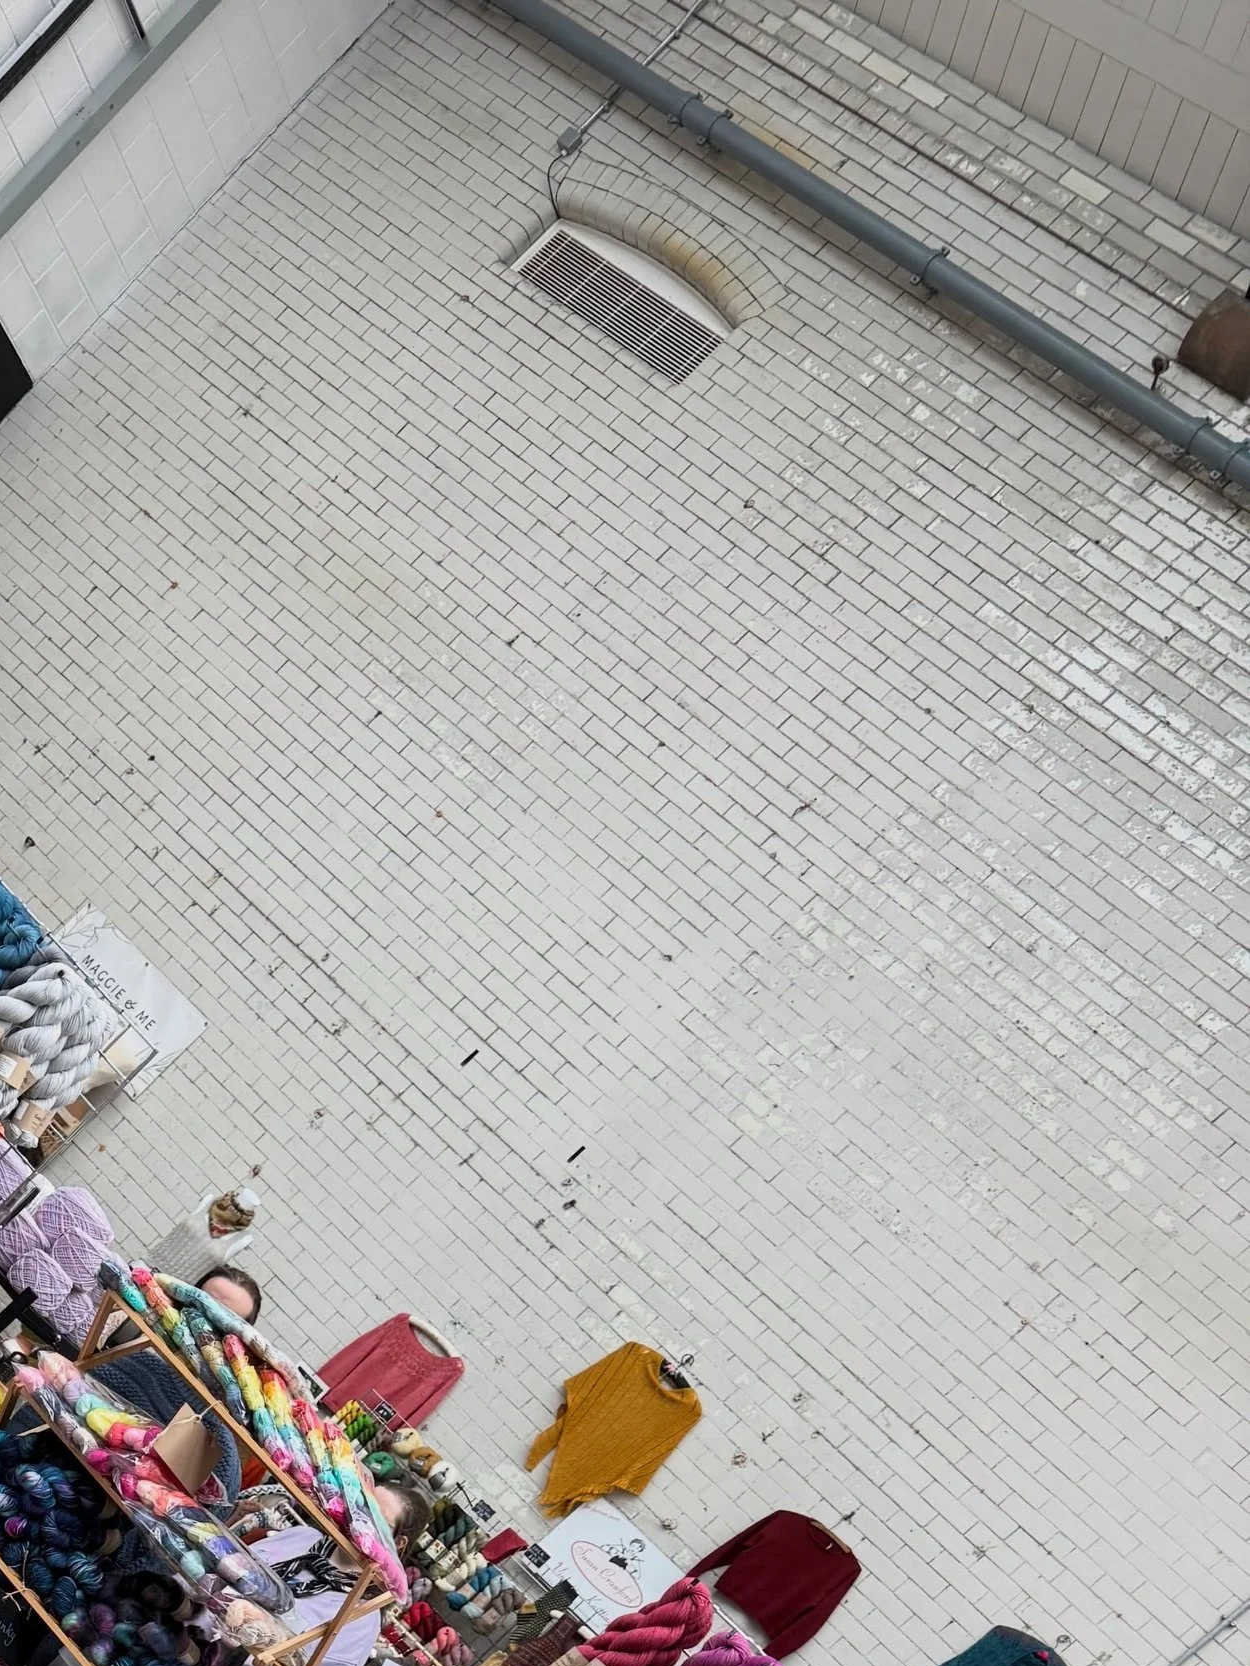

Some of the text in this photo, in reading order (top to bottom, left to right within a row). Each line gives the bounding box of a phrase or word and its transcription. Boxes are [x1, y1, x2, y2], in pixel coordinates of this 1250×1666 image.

[82, 954, 156, 1031] MAGGIE & ME
[576, 1545, 640, 1604] Susan Crawford
